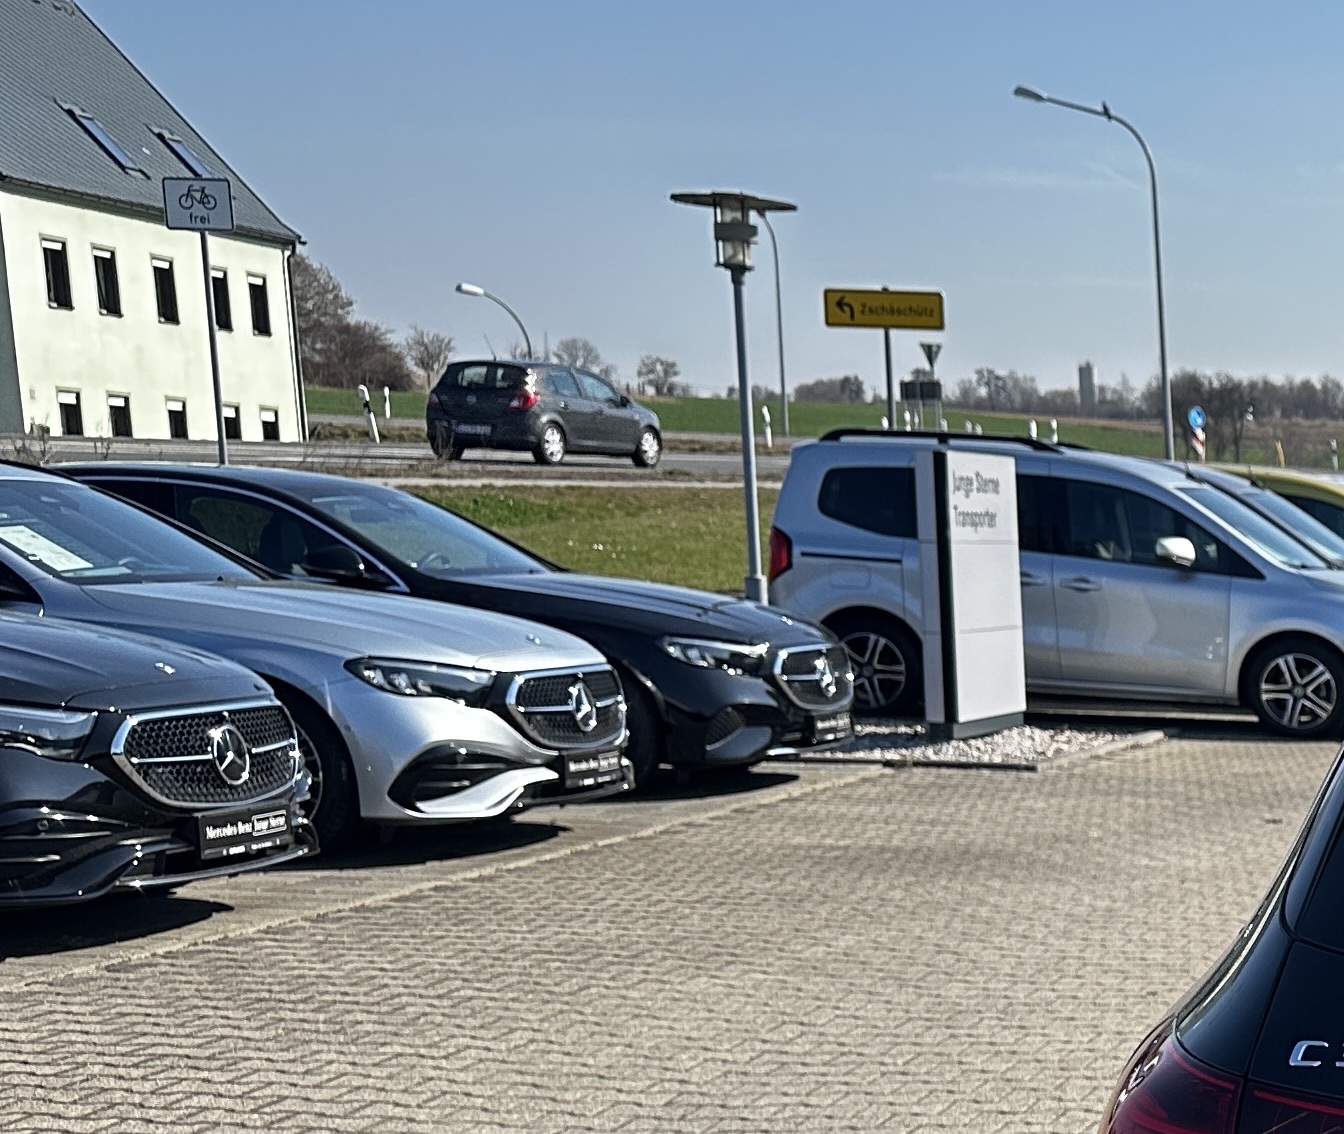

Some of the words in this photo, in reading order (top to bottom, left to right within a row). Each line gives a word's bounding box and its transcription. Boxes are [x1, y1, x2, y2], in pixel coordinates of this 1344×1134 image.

[189, 212, 211, 225] frei
[952, 469, 974, 499] Junge
[975, 470, 1000, 495] Sterne
[1288, 1040, 1329, 1067] C
